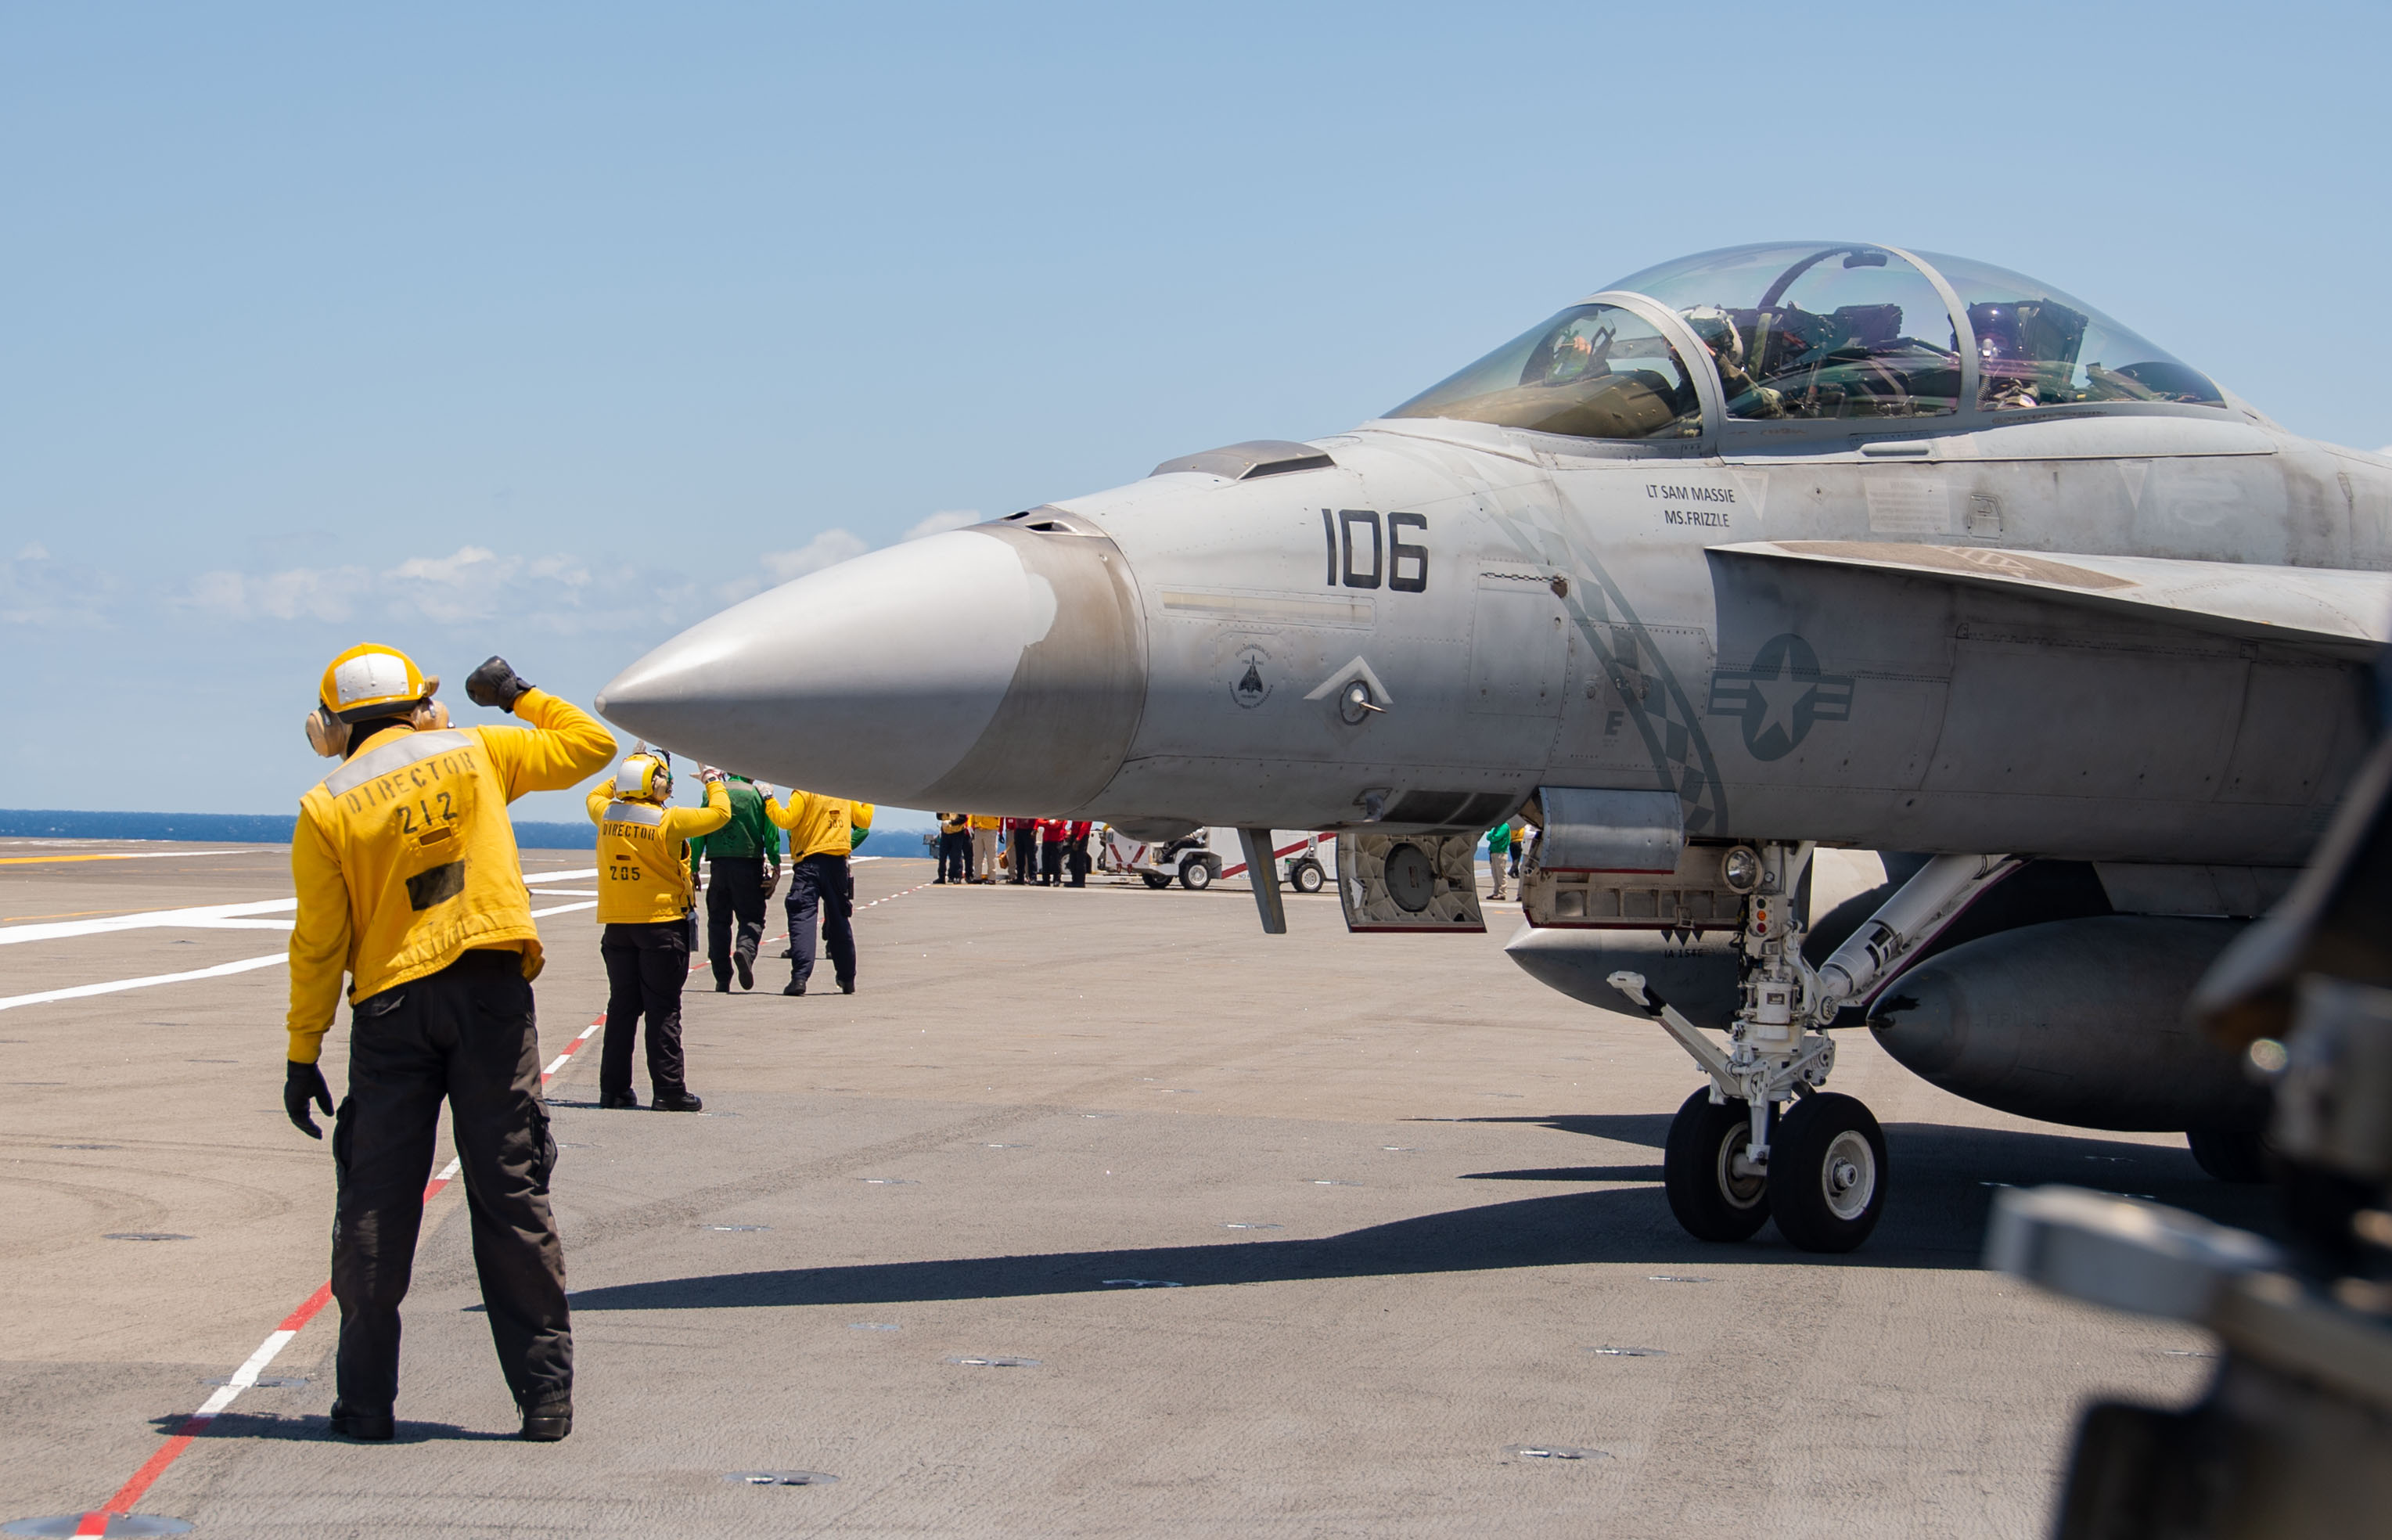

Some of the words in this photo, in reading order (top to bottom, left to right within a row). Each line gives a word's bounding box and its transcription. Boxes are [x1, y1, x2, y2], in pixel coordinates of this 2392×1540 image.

[1646, 484, 1658, 498] LT
[1660, 485, 1689, 500] SAM
[1691, 487, 1736, 502] MASSIE
[1664, 509, 1730, 527] MS.FRIZZLE
[1321, 508, 1428, 592] 106
[345, 752, 476, 815] DIRECTOR
[397, 791, 459, 835] 212
[602, 824, 656, 841] DIRECTOR
[610, 865, 641, 881] 205
